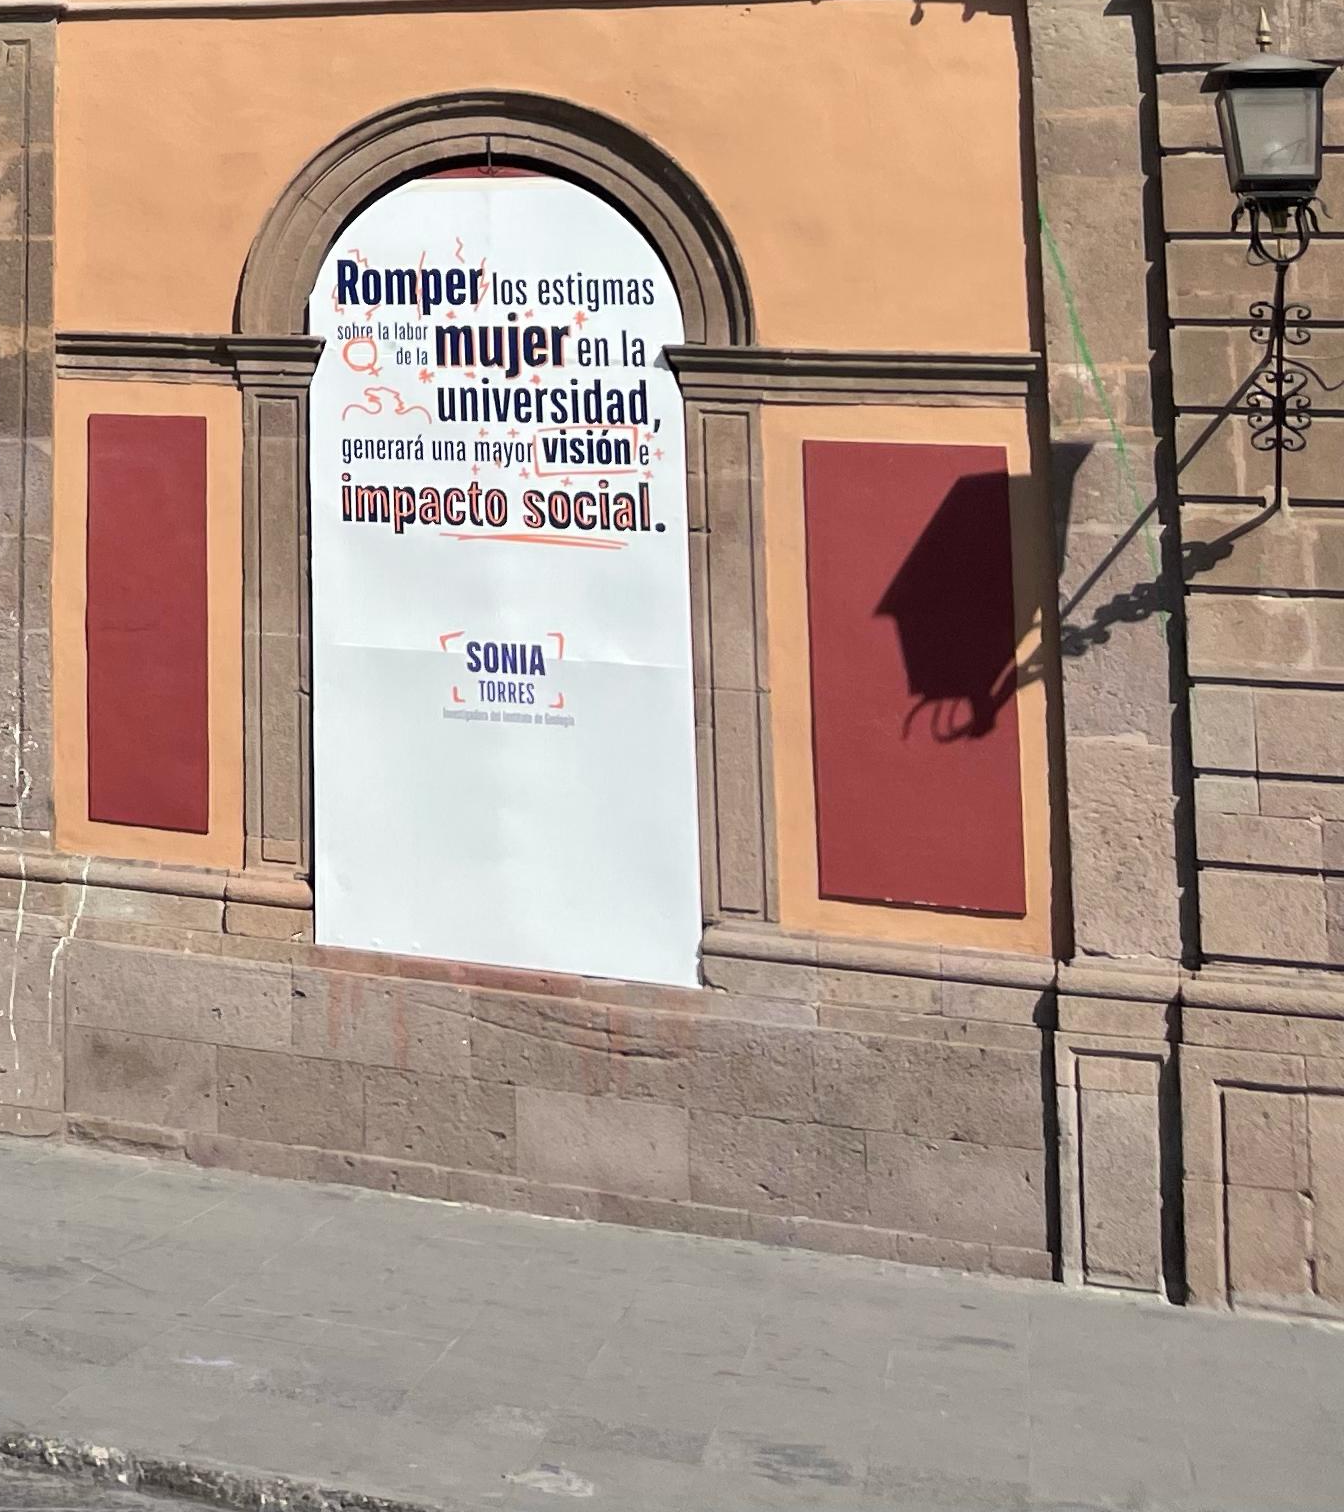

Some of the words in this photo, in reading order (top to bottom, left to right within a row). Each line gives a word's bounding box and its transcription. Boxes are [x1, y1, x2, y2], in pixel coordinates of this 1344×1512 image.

[337, 259, 483, 316] Romper
[492, 272, 528, 306] los
[537, 272, 655, 312] estigmas
[337, 322, 373, 340] sobre
[378, 322, 390, 340] la
[395, 322, 430, 340] labor
[396, 347, 412, 365] de
[416, 348, 429, 365] la
[435, 311, 571, 379] mujer
[577, 338, 610, 367] en
[621, 330, 646, 367] la
[437, 377, 661, 433] universidad,
[342, 434, 424, 464] generará
[432, 439, 467, 462] una
[474, 441, 533, 468] mayor
[542, 428, 632, 465] visión
[639, 444, 650, 465] e
[341, 472, 508, 535] impacto
[523, 479, 667, 534] social.
[466, 641, 546, 676] SONIA
[478, 679, 535, 705] TORRES
